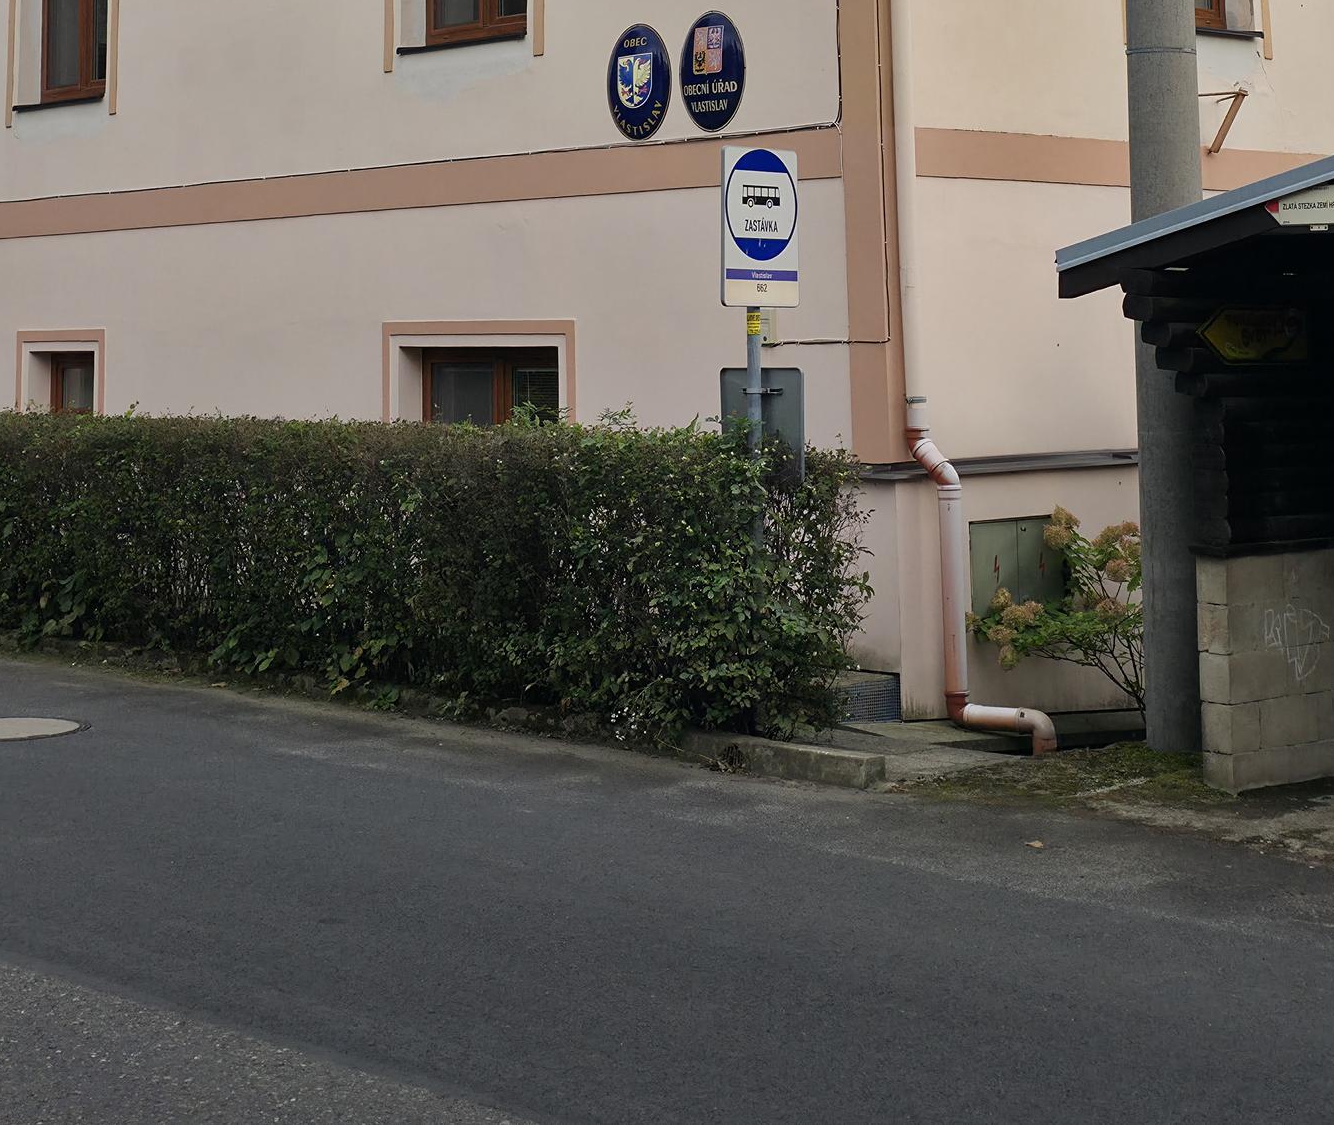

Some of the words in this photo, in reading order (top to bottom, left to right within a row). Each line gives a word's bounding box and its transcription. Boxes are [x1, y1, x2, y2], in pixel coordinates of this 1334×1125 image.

[623, 37, 648, 48] OBEC
[683, 81, 709, 96] OBECNÍ
[711, 79, 738, 93] ÚŘAD
[690, 99, 728, 113] VLASTISLAV
[613, 100, 663, 136] VLASTISLAV
[1283, 202, 1297, 210] ZLATÁ
[1317, 201, 1328, 209] ZEMÍ
[744, 218, 778, 233] ZASTÁVKA
[751, 271, 773, 279] Vlastislav
